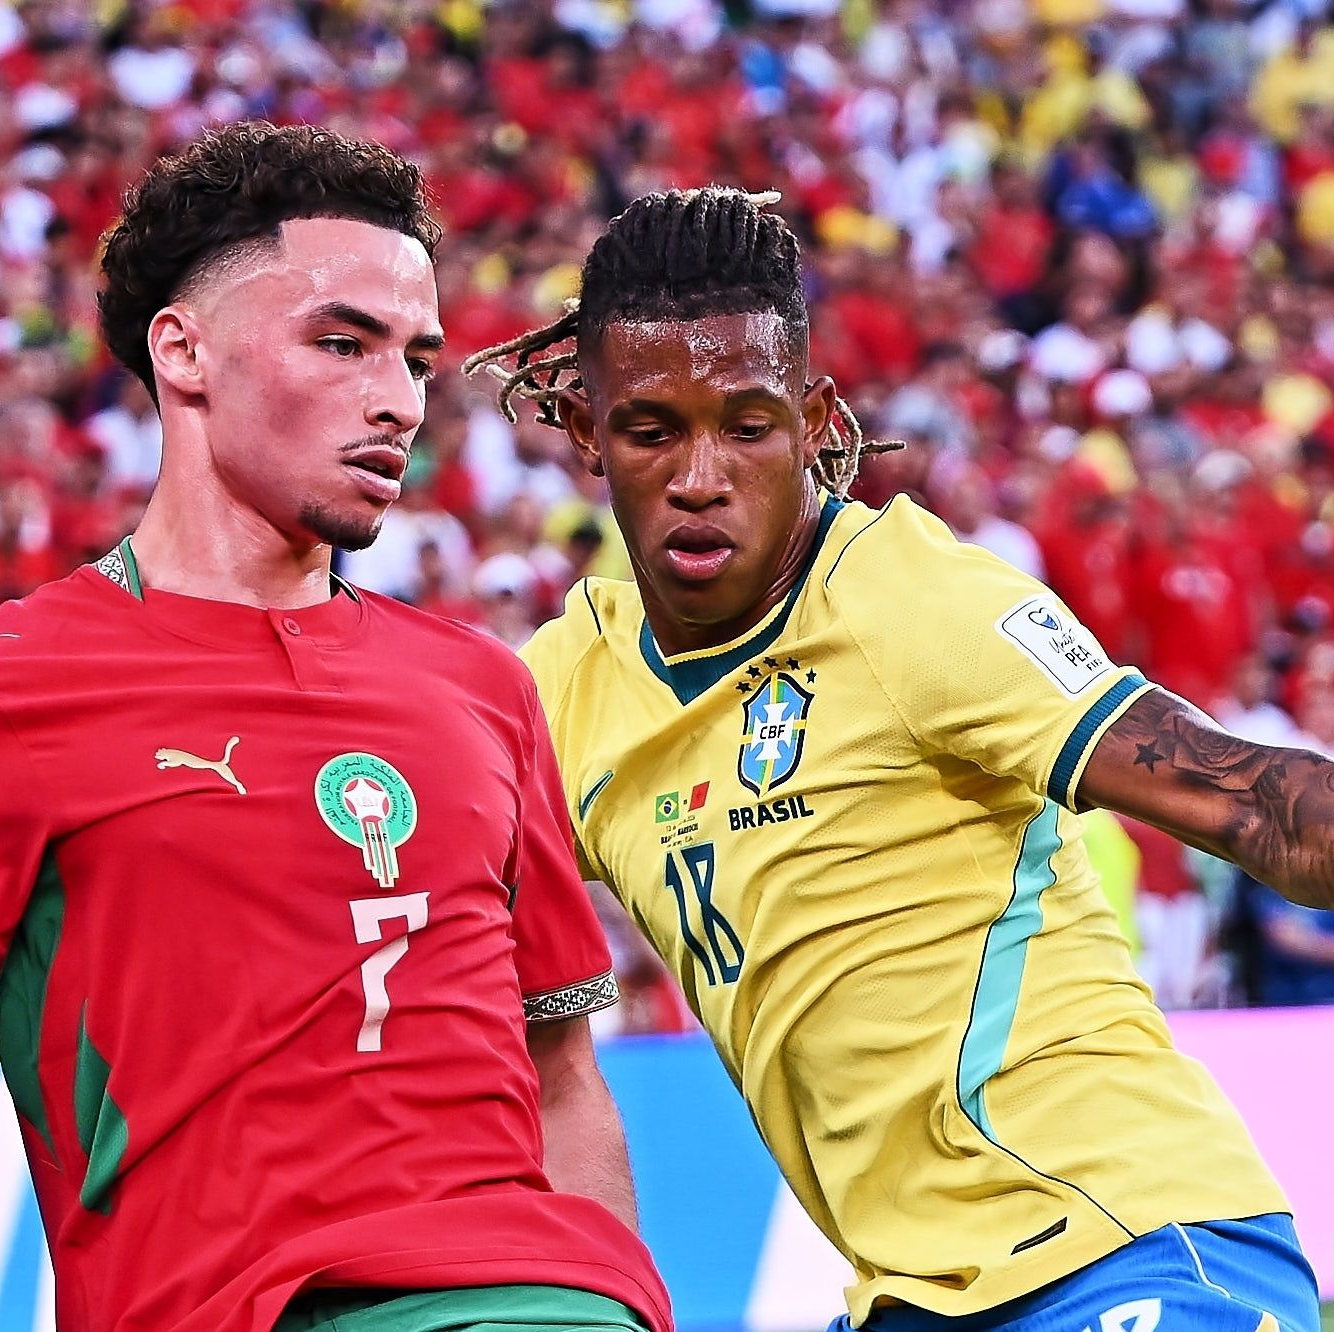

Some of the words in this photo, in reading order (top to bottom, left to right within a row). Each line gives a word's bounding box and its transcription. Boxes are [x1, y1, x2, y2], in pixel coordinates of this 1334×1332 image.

[760, 724, 786, 740] CBF
[728, 795, 814, 831] BRASIL
[665, 841, 745, 988] 18
[348, 891, 431, 1053] 7
